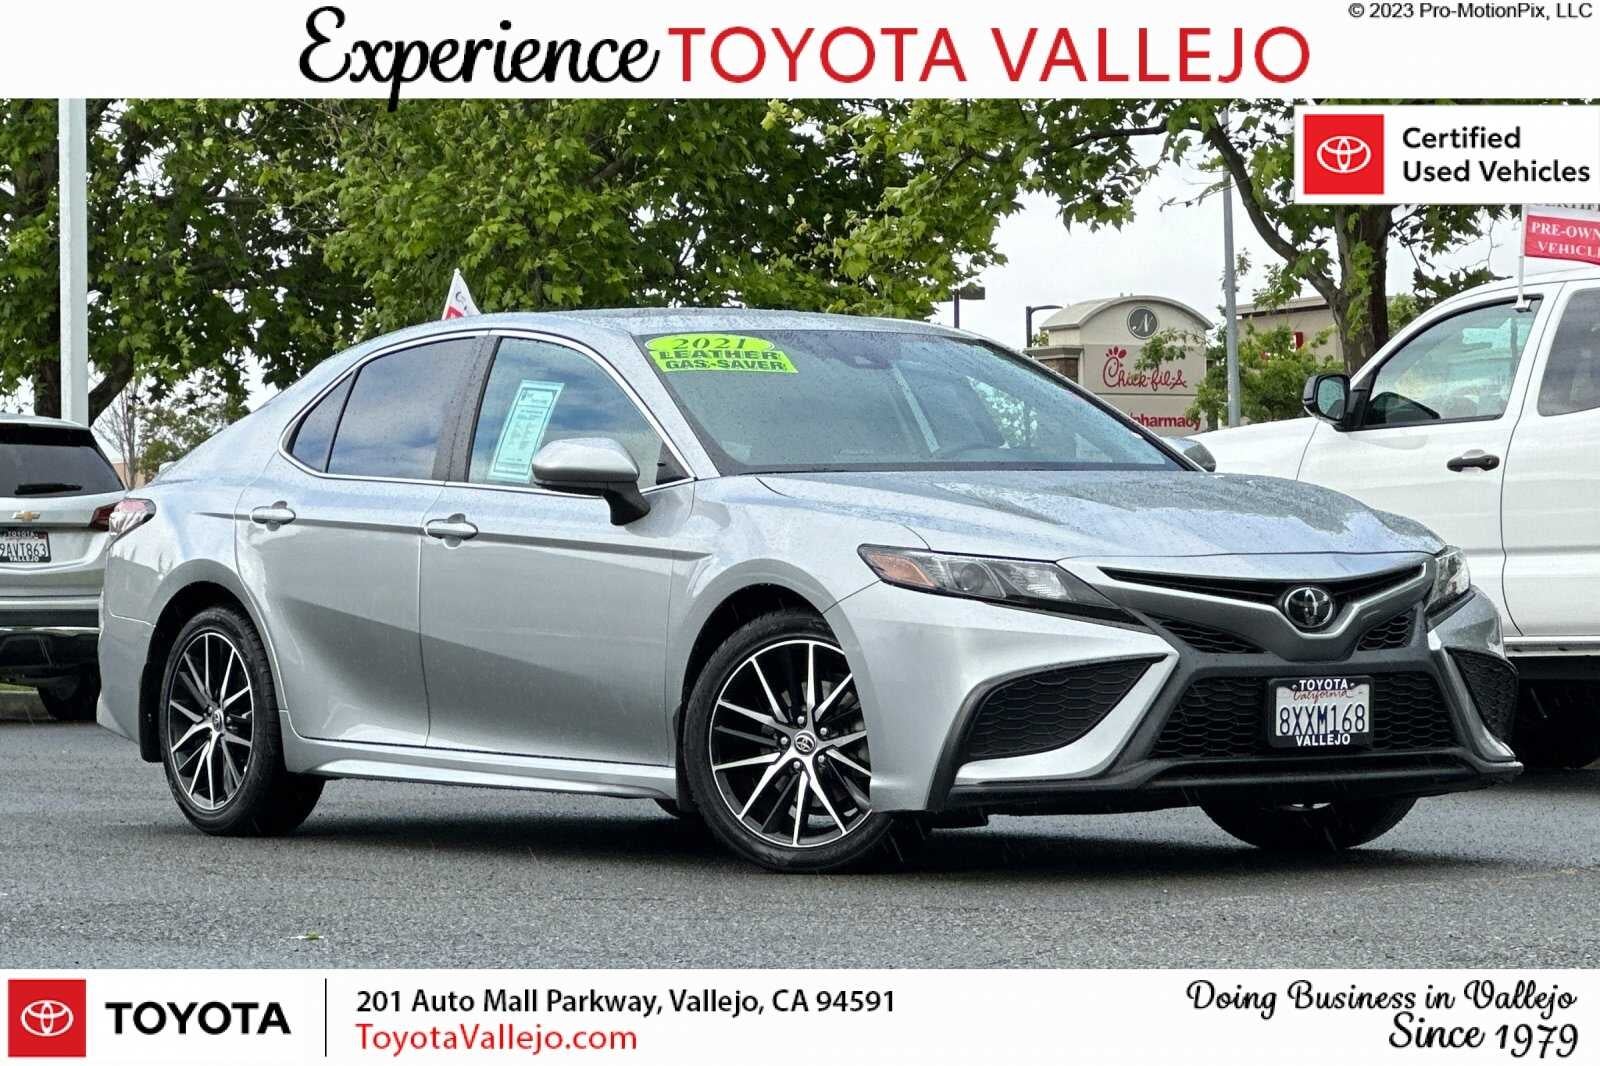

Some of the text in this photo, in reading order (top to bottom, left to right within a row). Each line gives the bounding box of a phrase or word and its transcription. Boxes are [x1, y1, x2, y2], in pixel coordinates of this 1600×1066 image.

[1538, 241, 1600, 258] VEHICL
[672, 337, 747, 350] 2021
[660, 350, 778, 360] LEATHER
[1103, 346, 1188, 391] Chick-fil-A
[1299, 679, 1348, 690] TOYOTA
[1280, 704, 1365, 736] 8XXM168
[1296, 734, 1351, 746] VALLEJO
